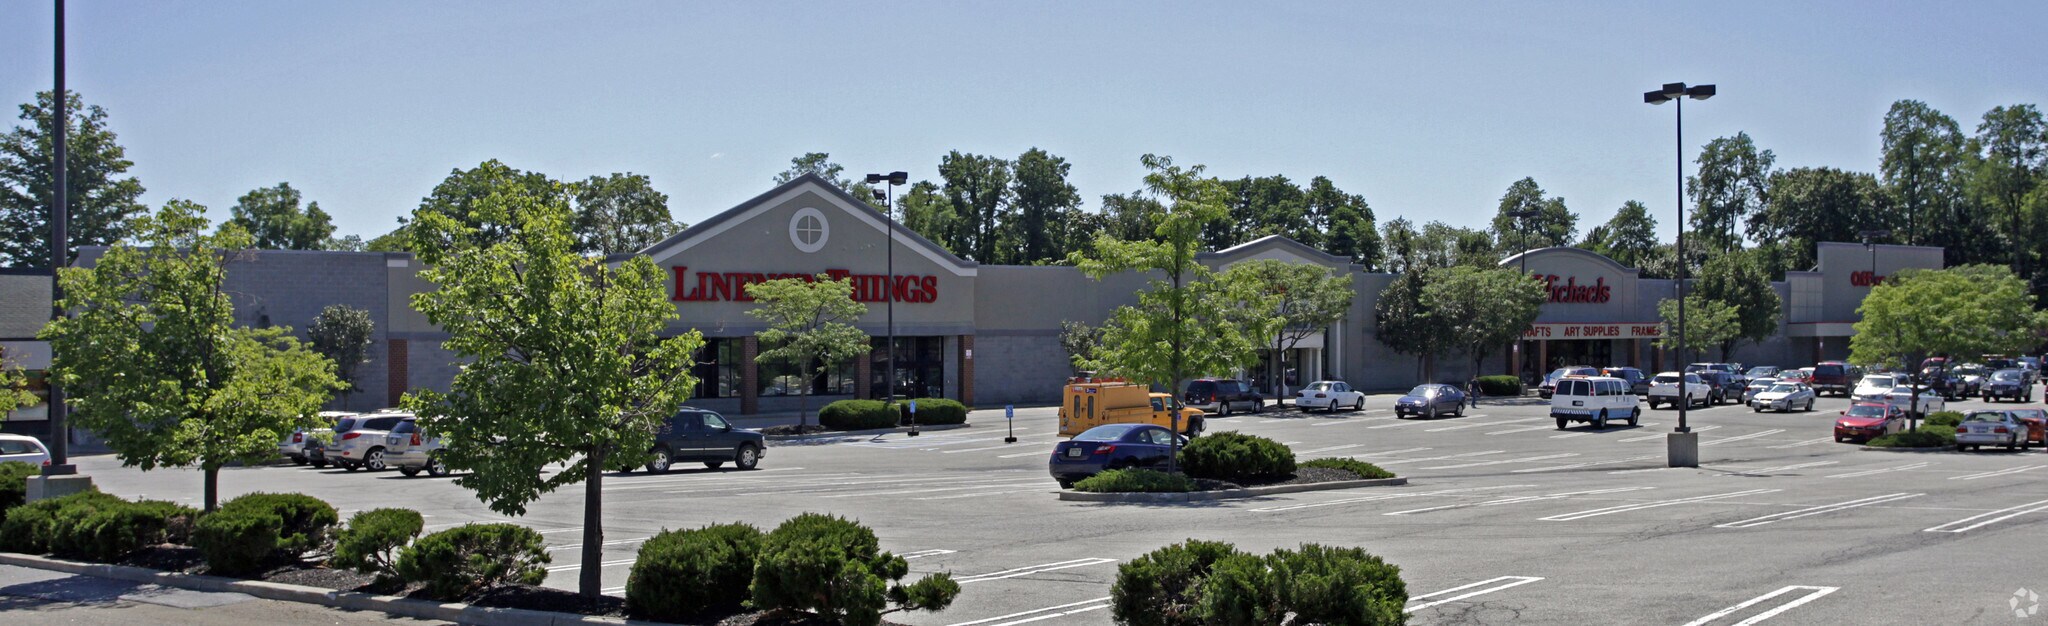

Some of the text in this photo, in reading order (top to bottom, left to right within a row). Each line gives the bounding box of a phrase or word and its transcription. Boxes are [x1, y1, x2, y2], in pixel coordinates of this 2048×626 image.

[671, 266, 794, 302] LINE
[1521, 326, 1551, 338] RAFTS
[1564, 327, 1581, 337] ART
[1583, 326, 1620, 337] SUPPLIES
